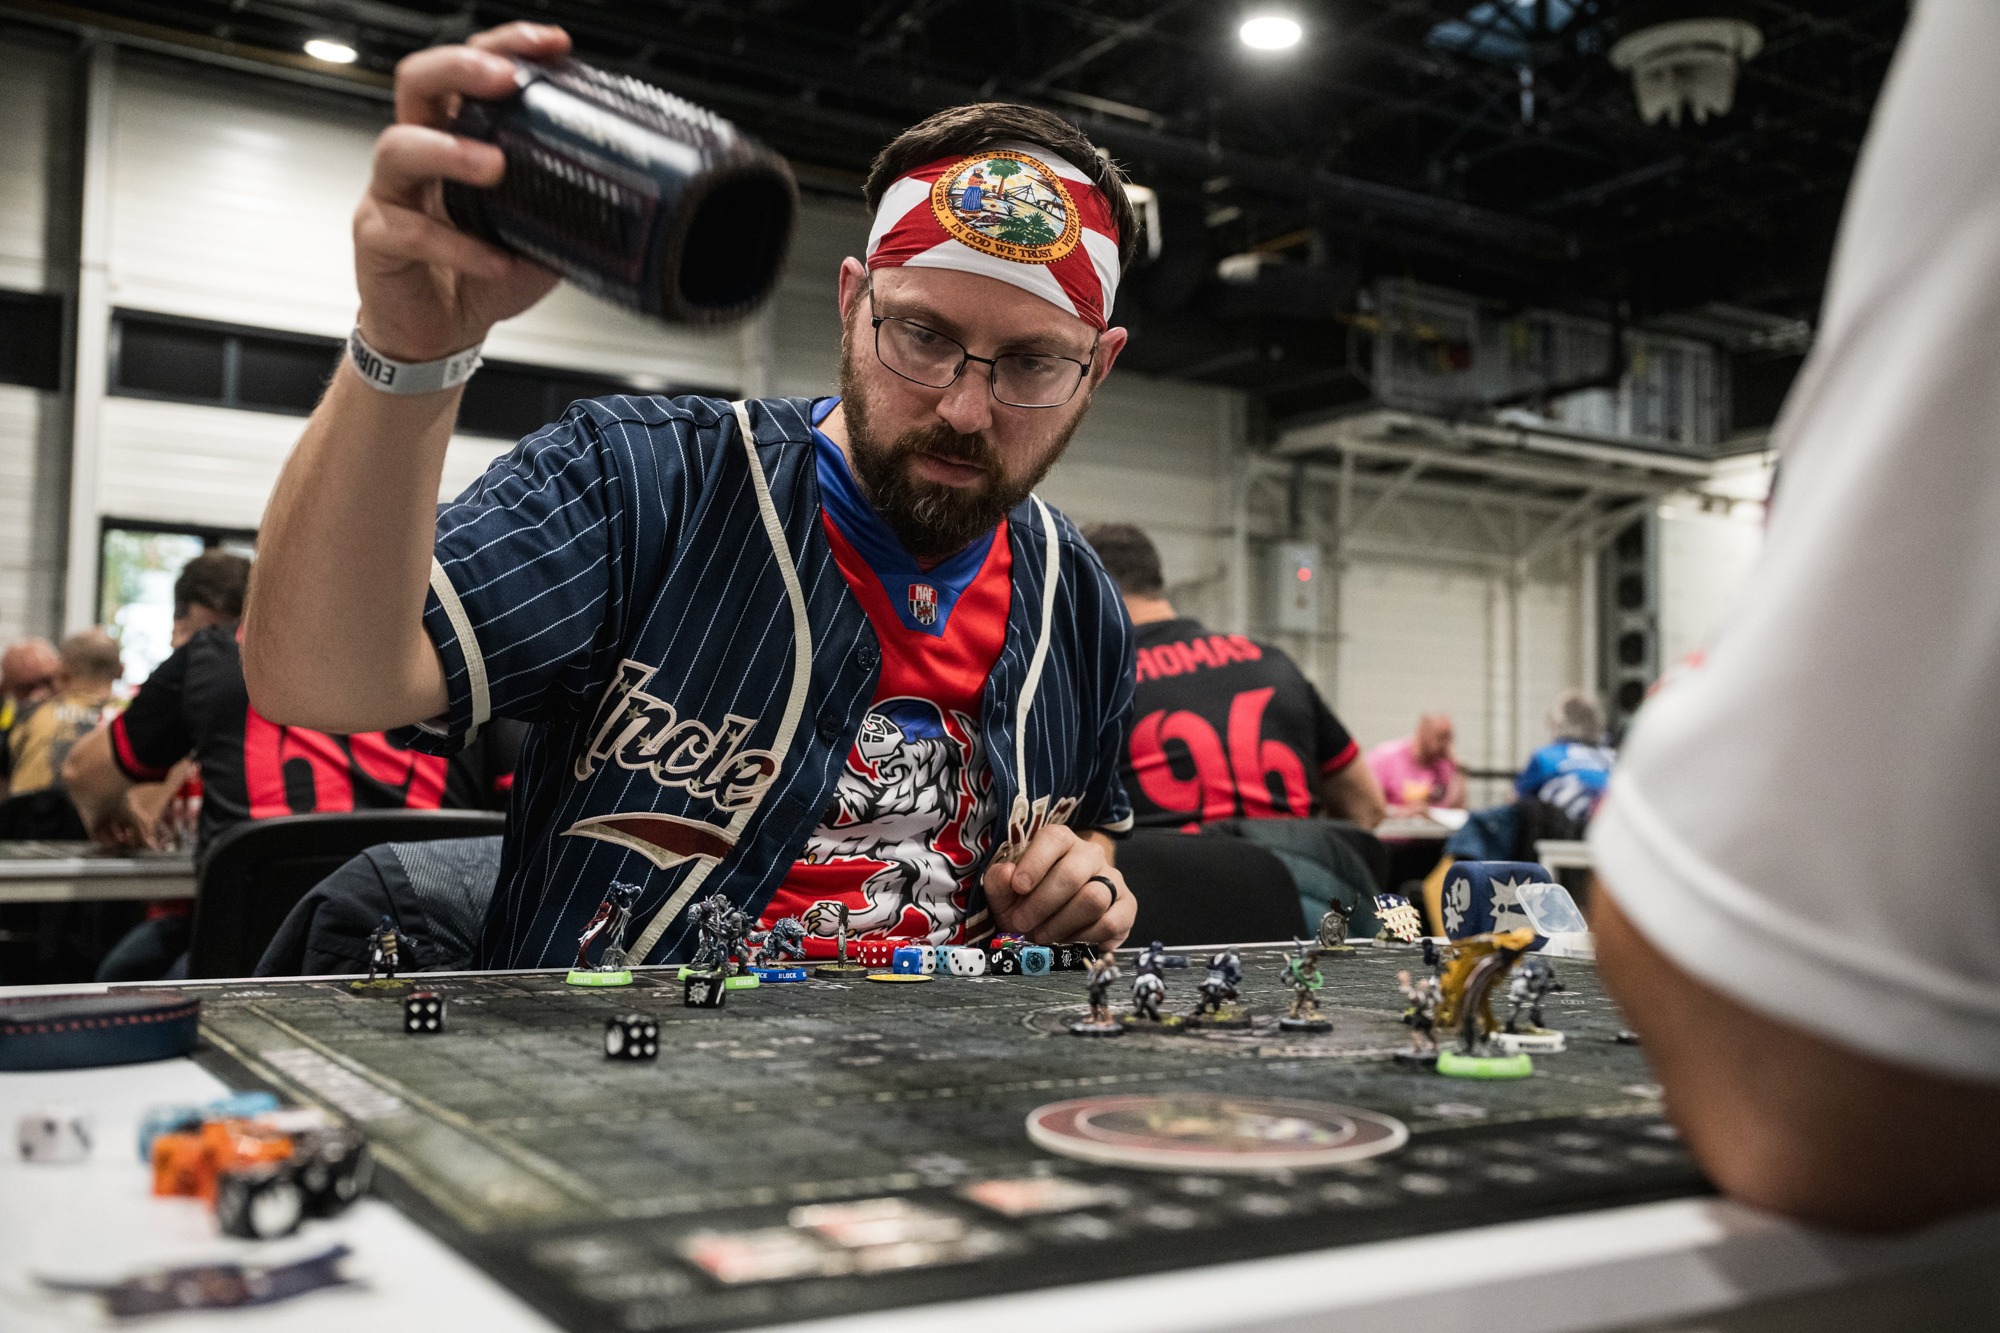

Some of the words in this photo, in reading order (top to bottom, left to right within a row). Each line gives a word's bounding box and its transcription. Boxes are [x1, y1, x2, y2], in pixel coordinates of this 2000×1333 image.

[974, 153, 989, 161] OF
[994, 151, 1023, 160] THE
[945, 161, 971, 179] SEAL
[1028, 159, 1059, 186] STATE
[935, 181, 946, 211] GREAT
[1060, 190, 1072, 205] OF
[1061, 206, 1077, 248] FLORIDA
[950, 222, 966, 234] IN
[964, 231, 991, 248] GOD
[994, 243, 1017, 256] WE
[1018, 248, 1053, 259] TRUST
[351, 343, 397, 386] EUR
[915, 585, 933, 602] NAF
[1128, 687, 1311, 834] 96
[1002, 959, 1014, 973] 3
